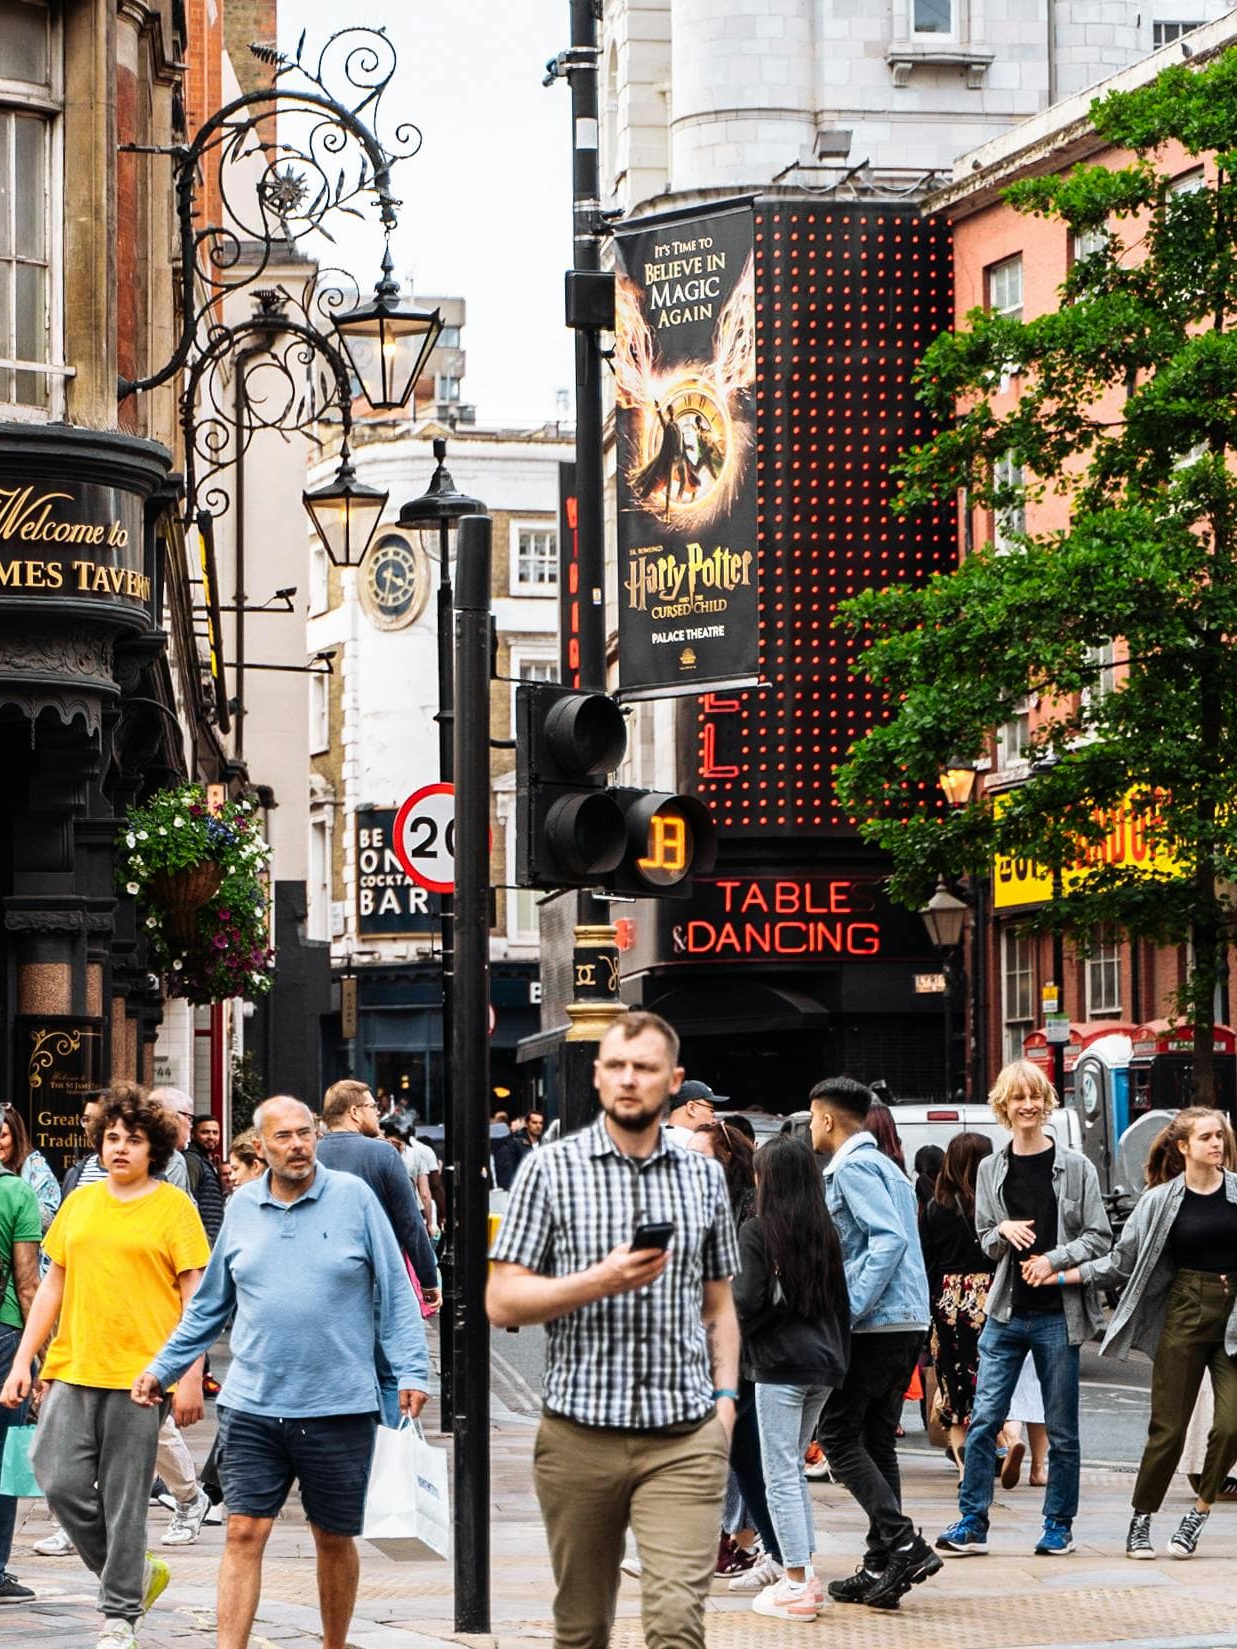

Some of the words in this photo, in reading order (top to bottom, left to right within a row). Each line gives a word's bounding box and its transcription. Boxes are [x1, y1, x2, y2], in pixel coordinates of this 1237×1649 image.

[672, 240, 697, 256] TIME
[698, 237, 713, 250] TO
[644, 256, 703, 286] BELIEVE
[707, 252, 726, 272] IN
[650, 276, 720, 310] MAGIC
[657, 303, 713, 329] AGAIN
[107, 519, 129, 548] to
[72, 560, 151, 601] TAVERN
[624, 554, 686, 612] Harry
[686, 542, 753, 608] Potter
[651, 602, 692, 619] CURSED
[693, 599, 728, 614] CHILD
[651, 630, 685, 645] PALACE
[685, 625, 725, 641] THEATRE
[359, 827, 384, 849] BE
[359, 847, 405, 874] ON
[360, 874, 416, 888] COCKTA
[360, 886, 429, 916] BAR
[687, 920, 880, 955] DANCING
